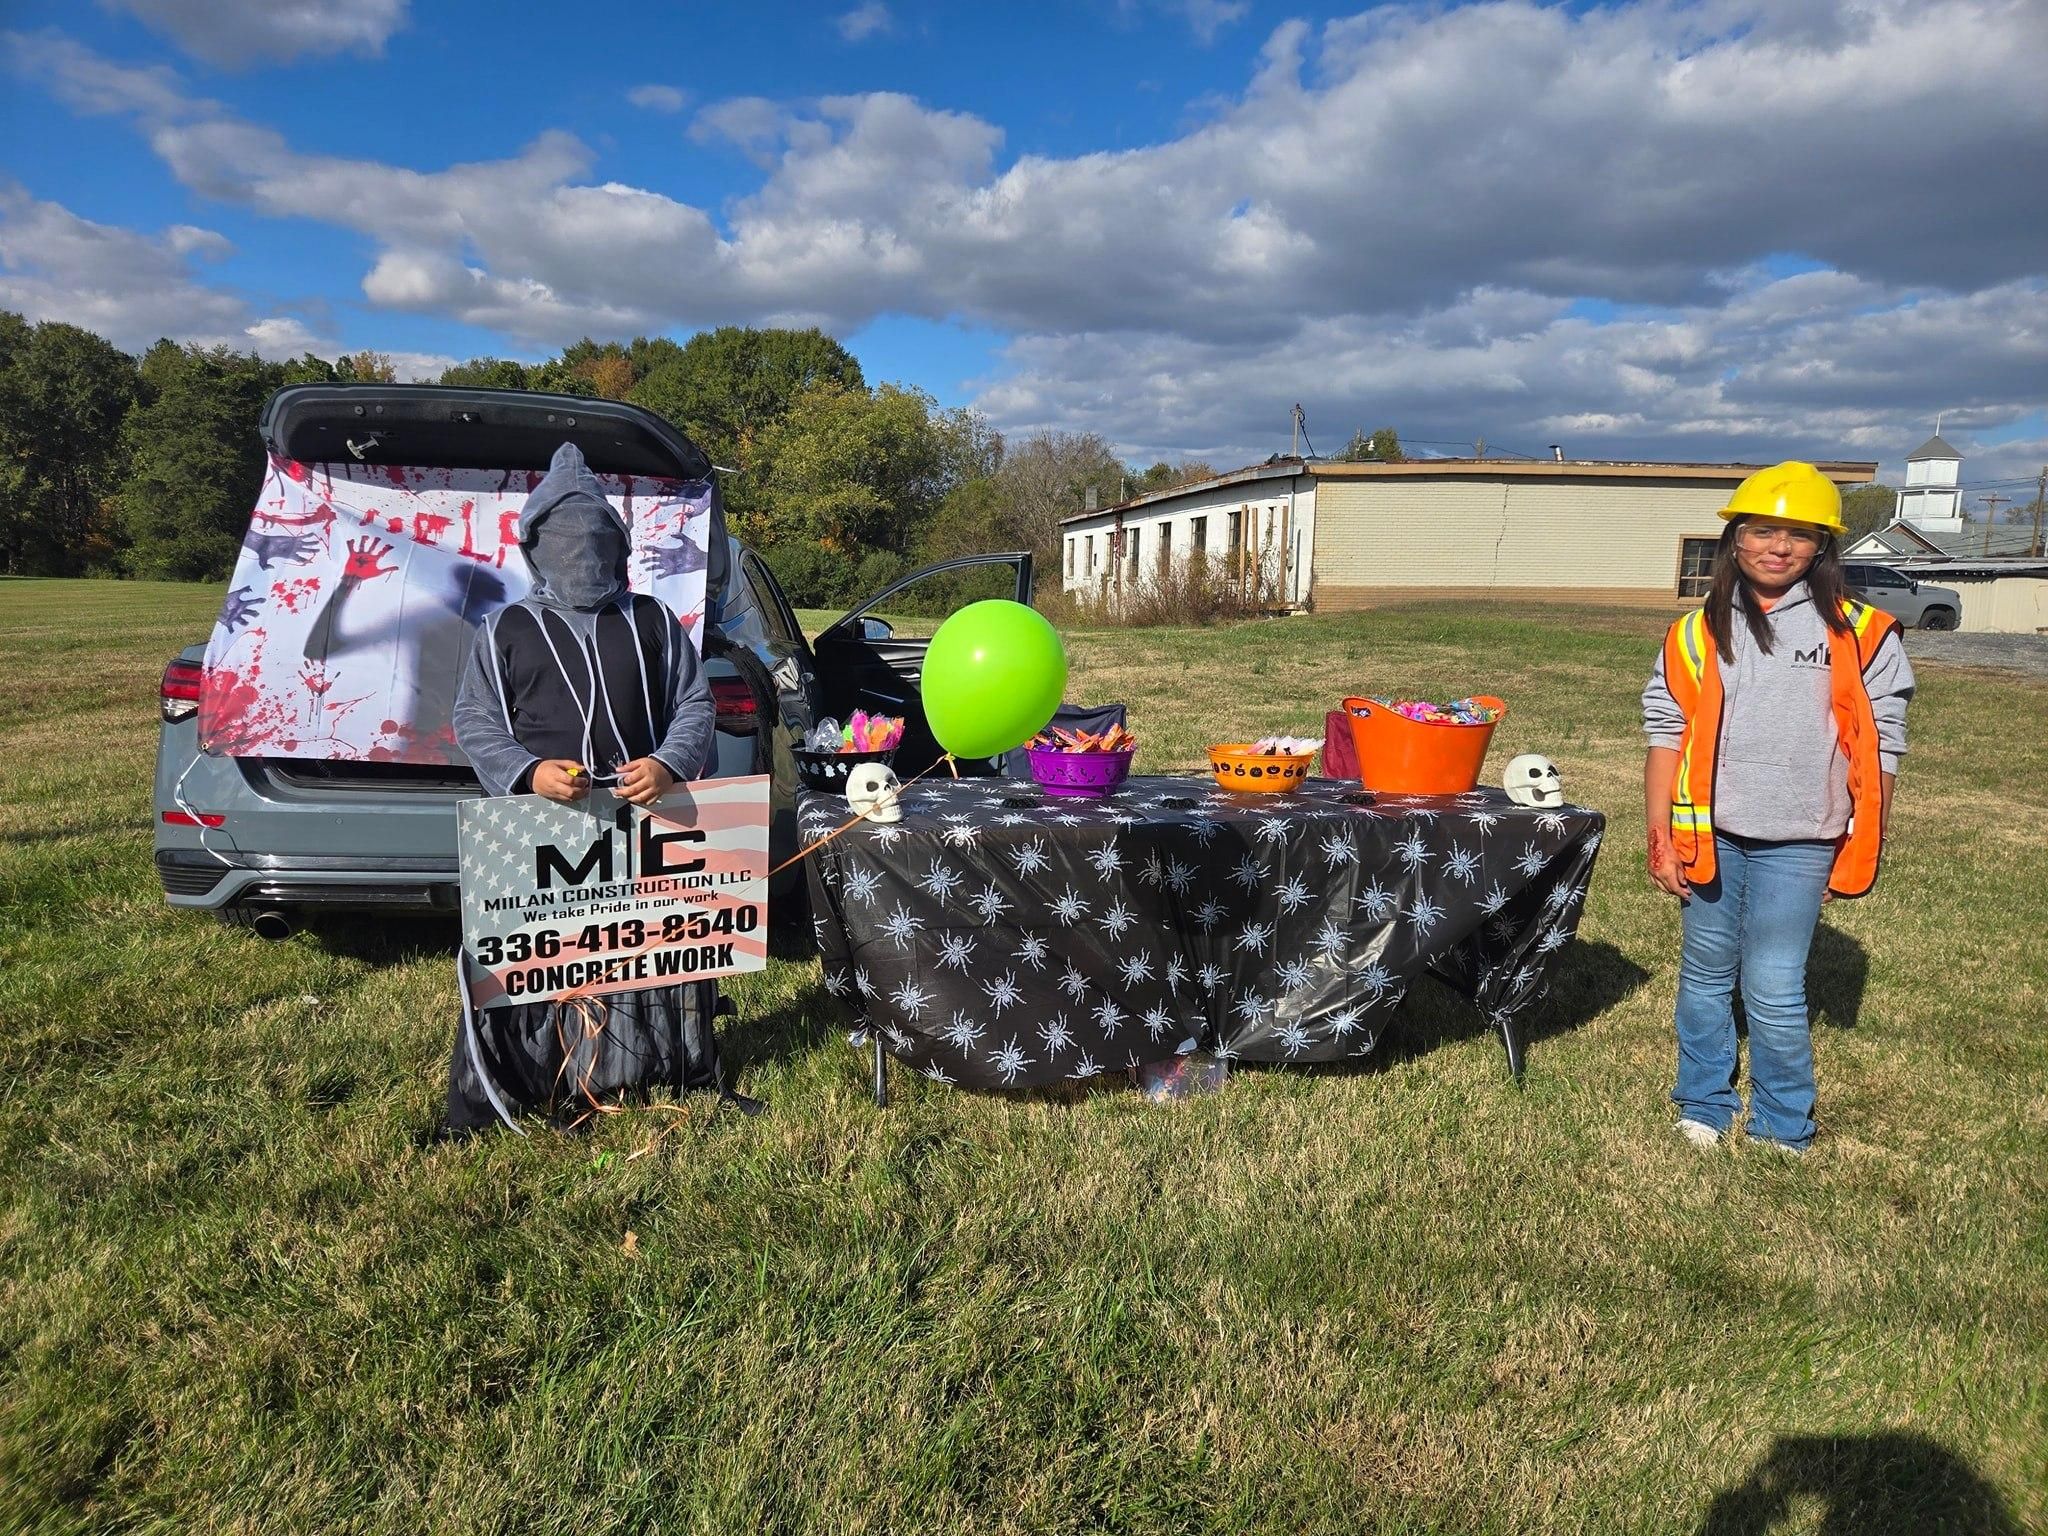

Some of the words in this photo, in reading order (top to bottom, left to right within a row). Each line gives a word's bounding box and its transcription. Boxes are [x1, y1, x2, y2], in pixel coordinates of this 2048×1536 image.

[523, 910, 547, 924] We
[552, 907, 585, 921] take
[590, 901, 631, 915] Pride
[635, 899, 649, 910] in
[653, 898, 679, 908] our
[683, 890, 719, 904] work
[562, 874, 713, 903] CONSTRUCTION
[720, 870, 752, 886] LLC
[477, 905, 758, 966] 336-413-8540
[505, 954, 648, 997] CONCRETE
[653, 942, 735, 978] WORK
